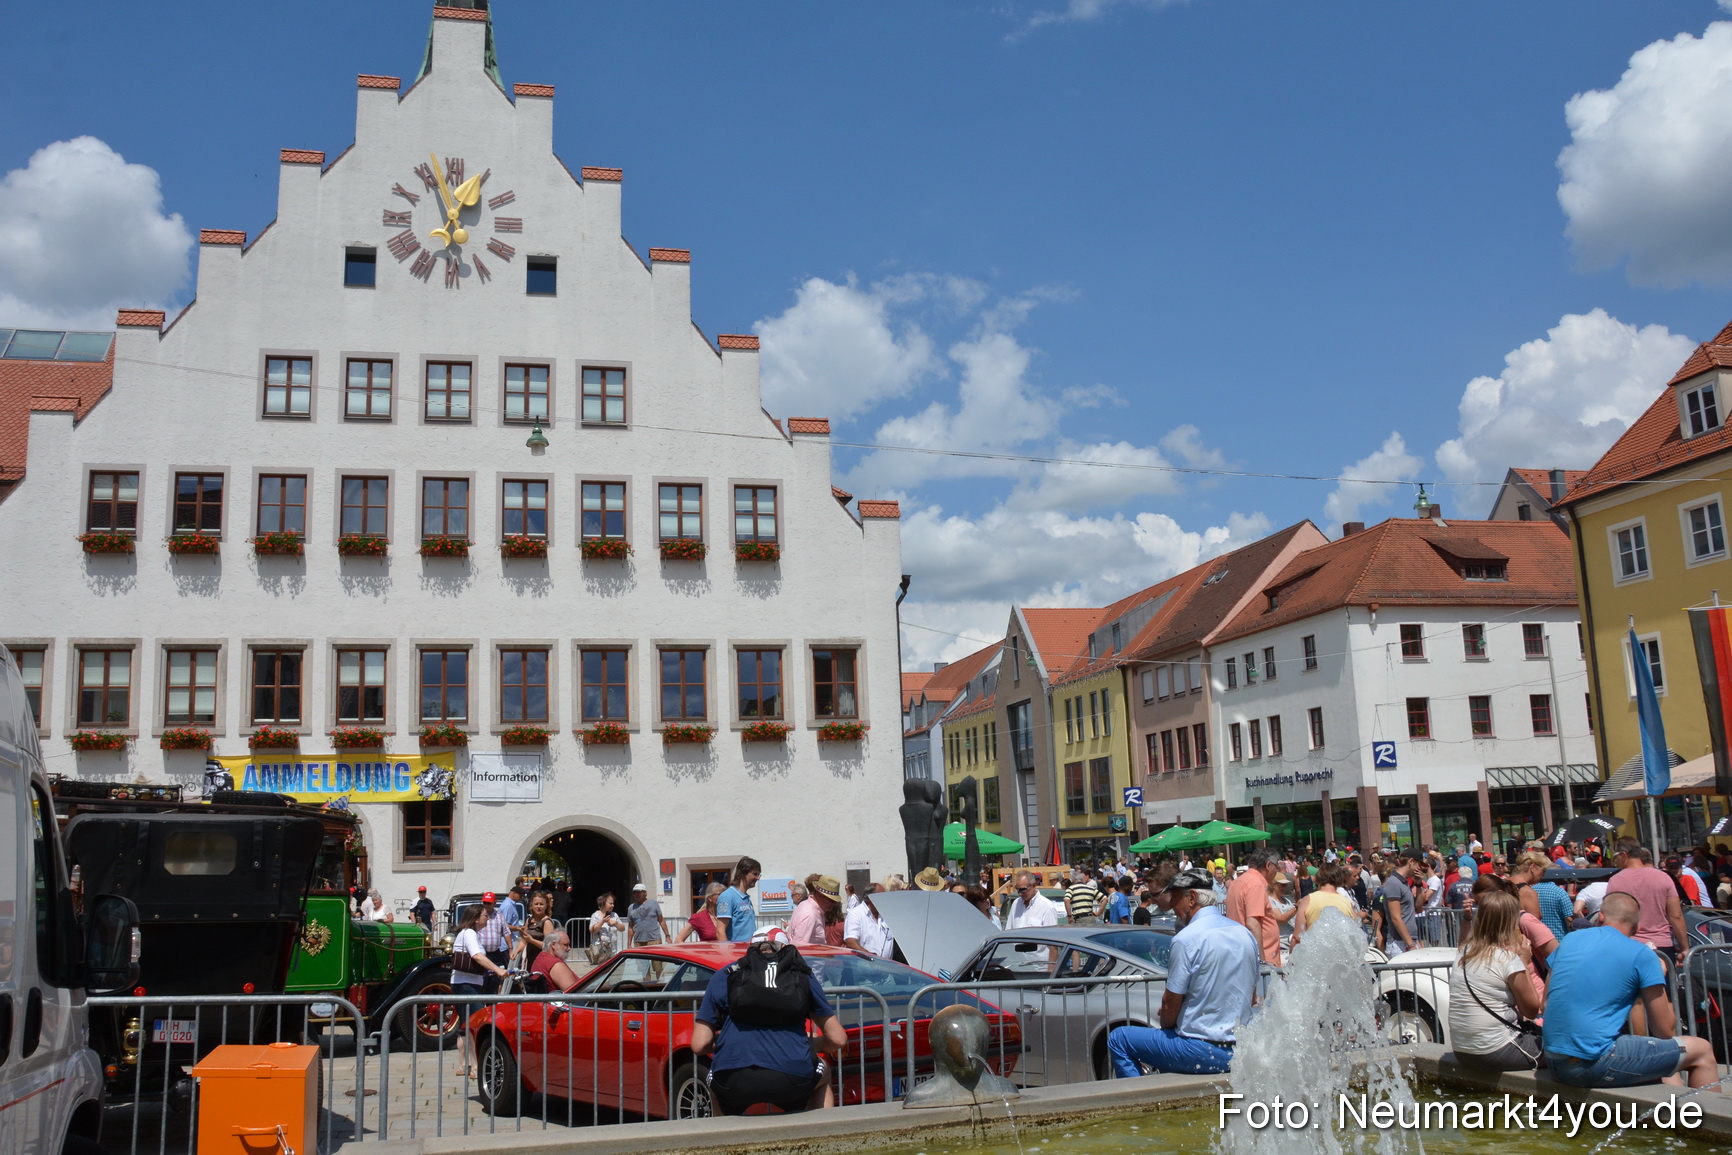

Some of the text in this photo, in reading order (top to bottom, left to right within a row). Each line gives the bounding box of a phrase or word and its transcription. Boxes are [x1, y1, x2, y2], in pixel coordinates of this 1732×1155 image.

[445, 158, 464, 185] XII
[392, 182, 420, 207] X
[241, 761, 412, 793] ANMELDUNG
[473, 771, 538, 783] Information
[1245, 767, 1334, 788] Buchhandlung Rupprecht
[761, 891, 787, 899] Kunst
